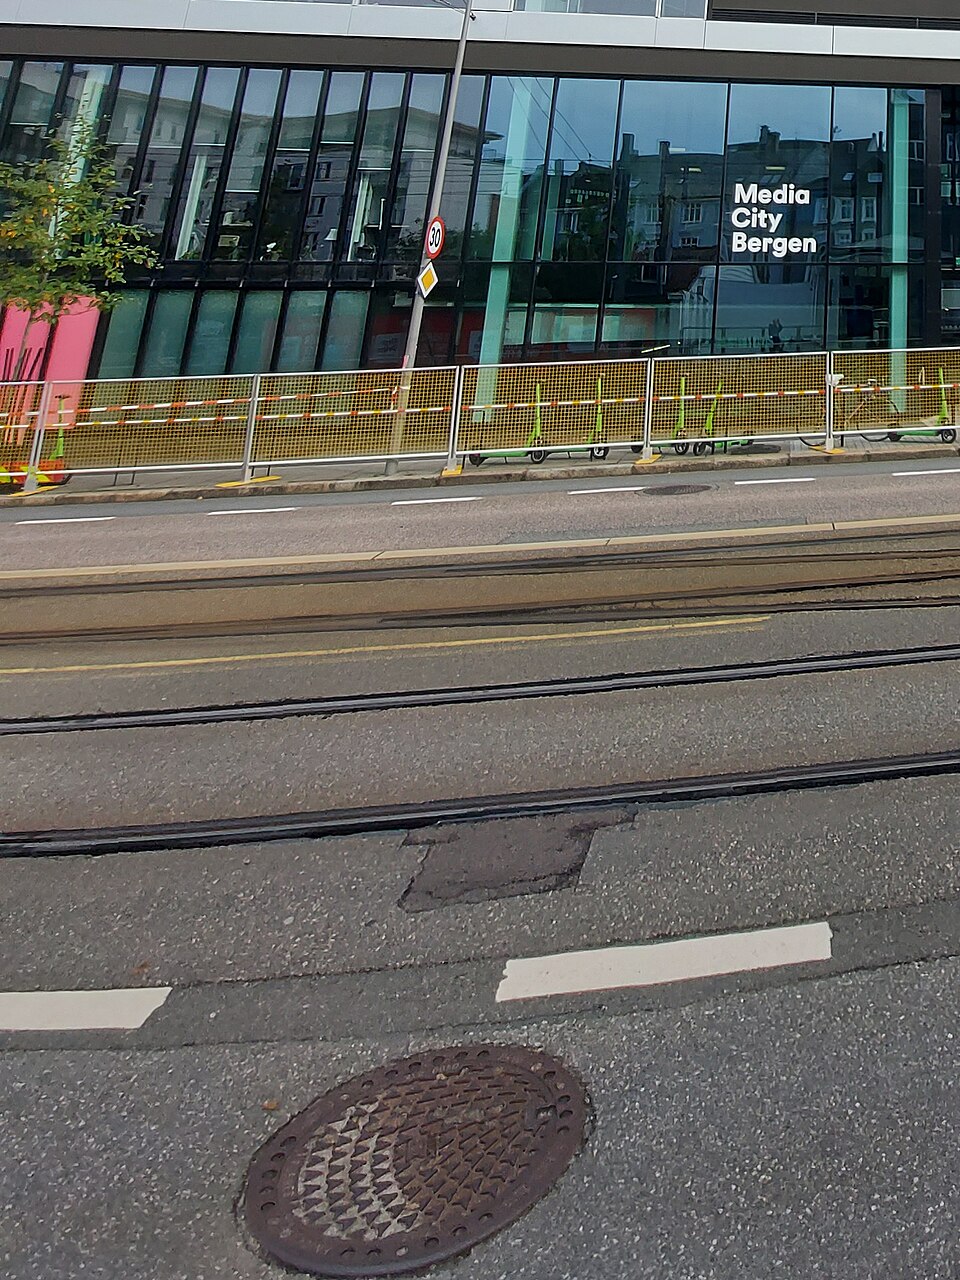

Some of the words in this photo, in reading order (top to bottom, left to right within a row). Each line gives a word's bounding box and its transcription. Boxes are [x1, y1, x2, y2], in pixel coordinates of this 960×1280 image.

[734, 183, 810, 204] Media
[732, 207, 783, 232] City
[430, 227, 441, 247] 30
[732, 231, 816, 257] Bergen
